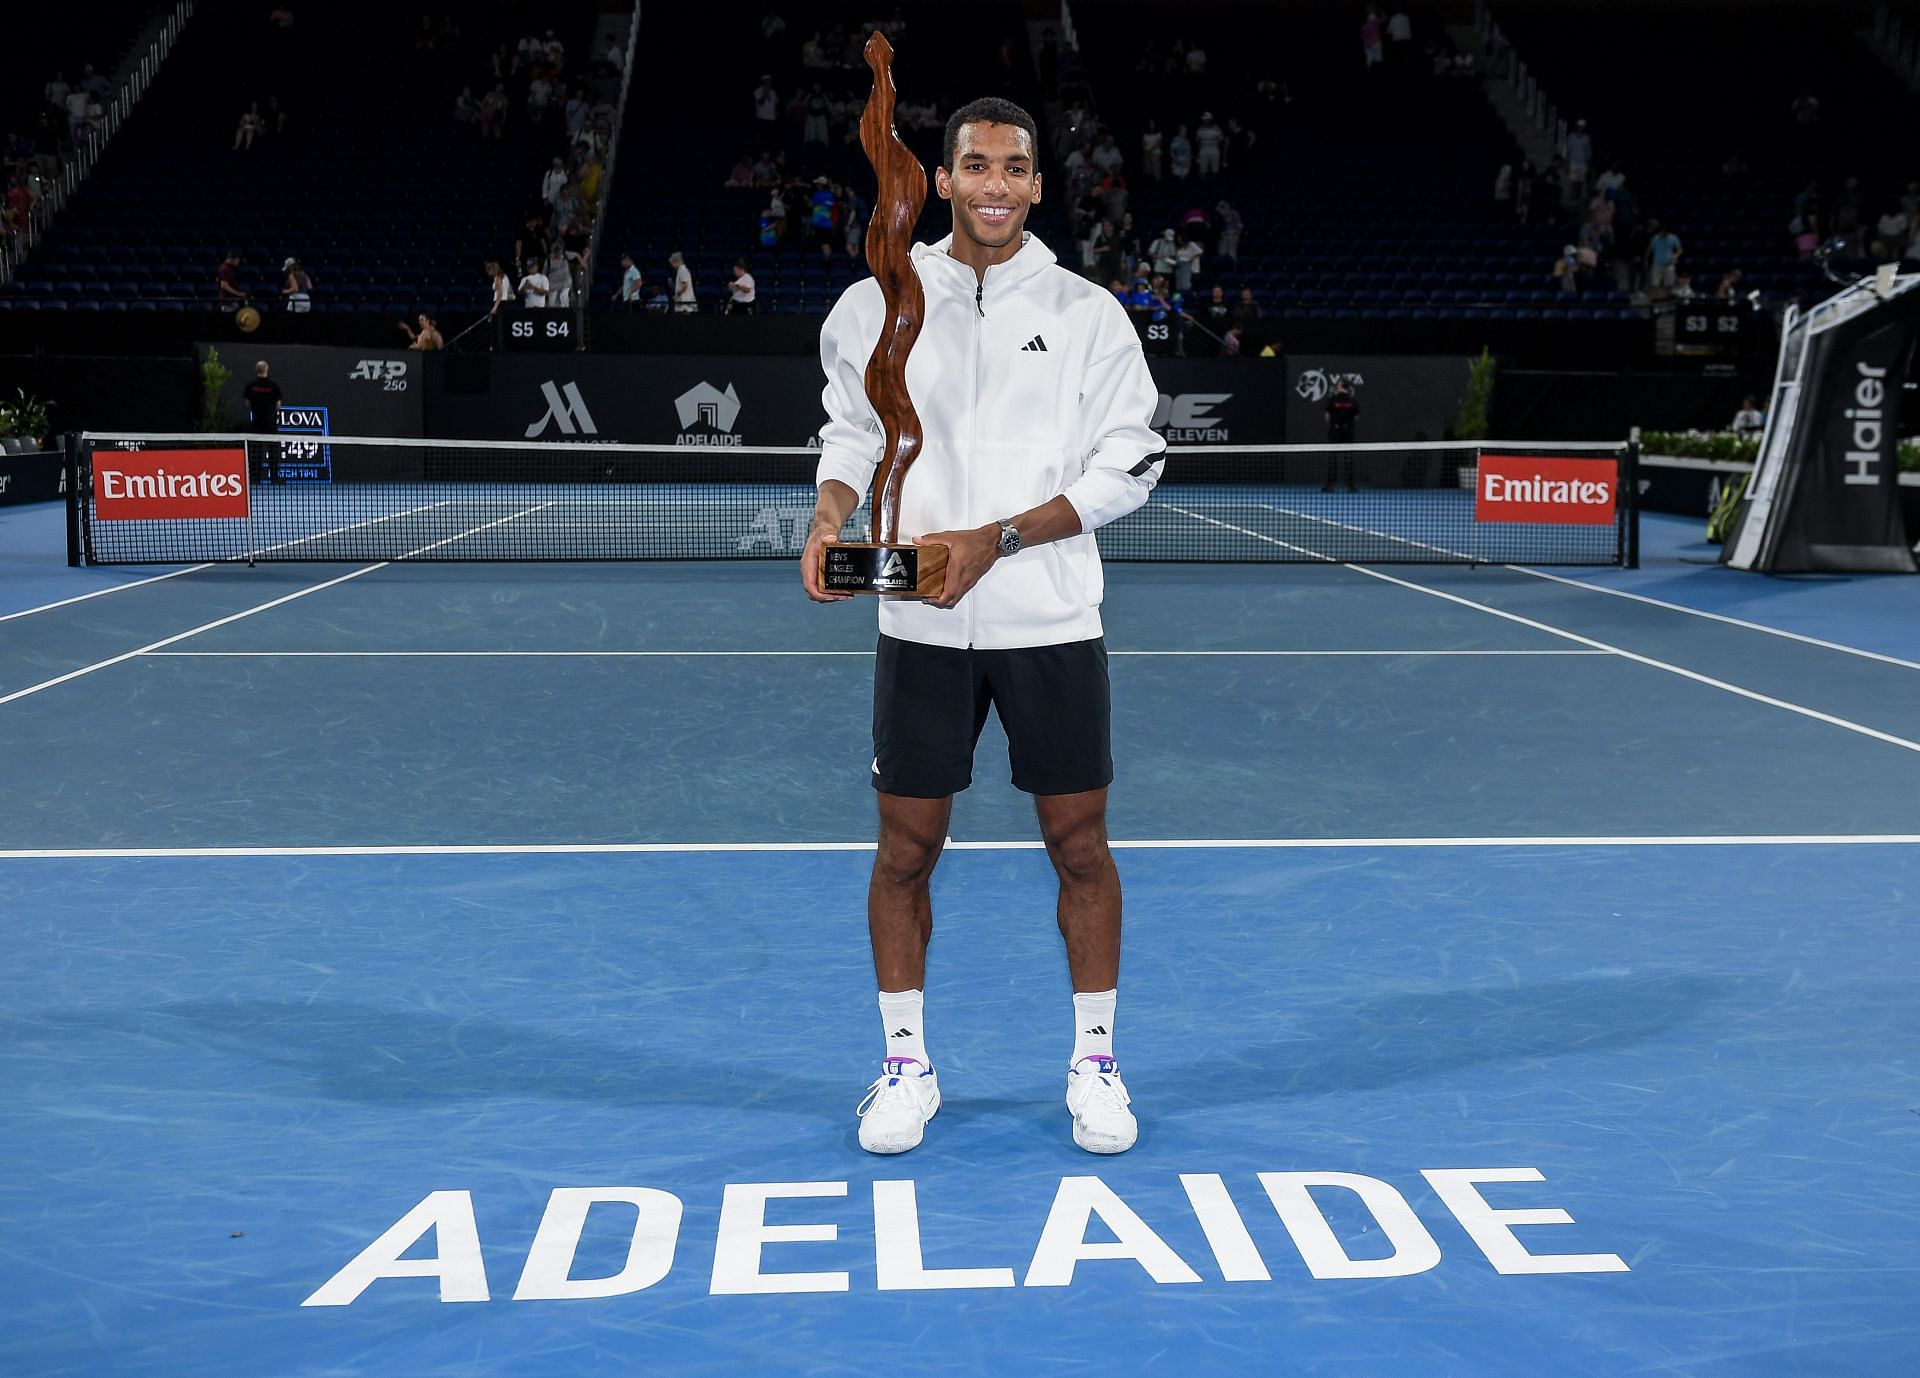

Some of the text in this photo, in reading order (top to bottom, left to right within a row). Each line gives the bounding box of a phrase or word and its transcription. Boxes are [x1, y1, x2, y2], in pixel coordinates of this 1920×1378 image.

[511, 321, 570, 338] S5 S4
[1685, 315, 1739, 332] S3 S2
[1147, 324, 1169, 340] S3
[349, 360, 407, 380] ATP
[383, 380, 407, 391] 250
[276, 411, 322, 426] LOVA
[1844, 362, 1886, 485] Haier
[675, 434, 742, 446] ADELAIDE
[1167, 429, 1228, 440] ELEVEN
[102, 468, 242, 498] Emirates
[1484, 473, 1609, 505] Emirates
[829, 564, 854, 573] SINGLES
[829, 575, 865, 584] CHAMPION
[301, 1167, 1630, 1307] ADELAIDE
